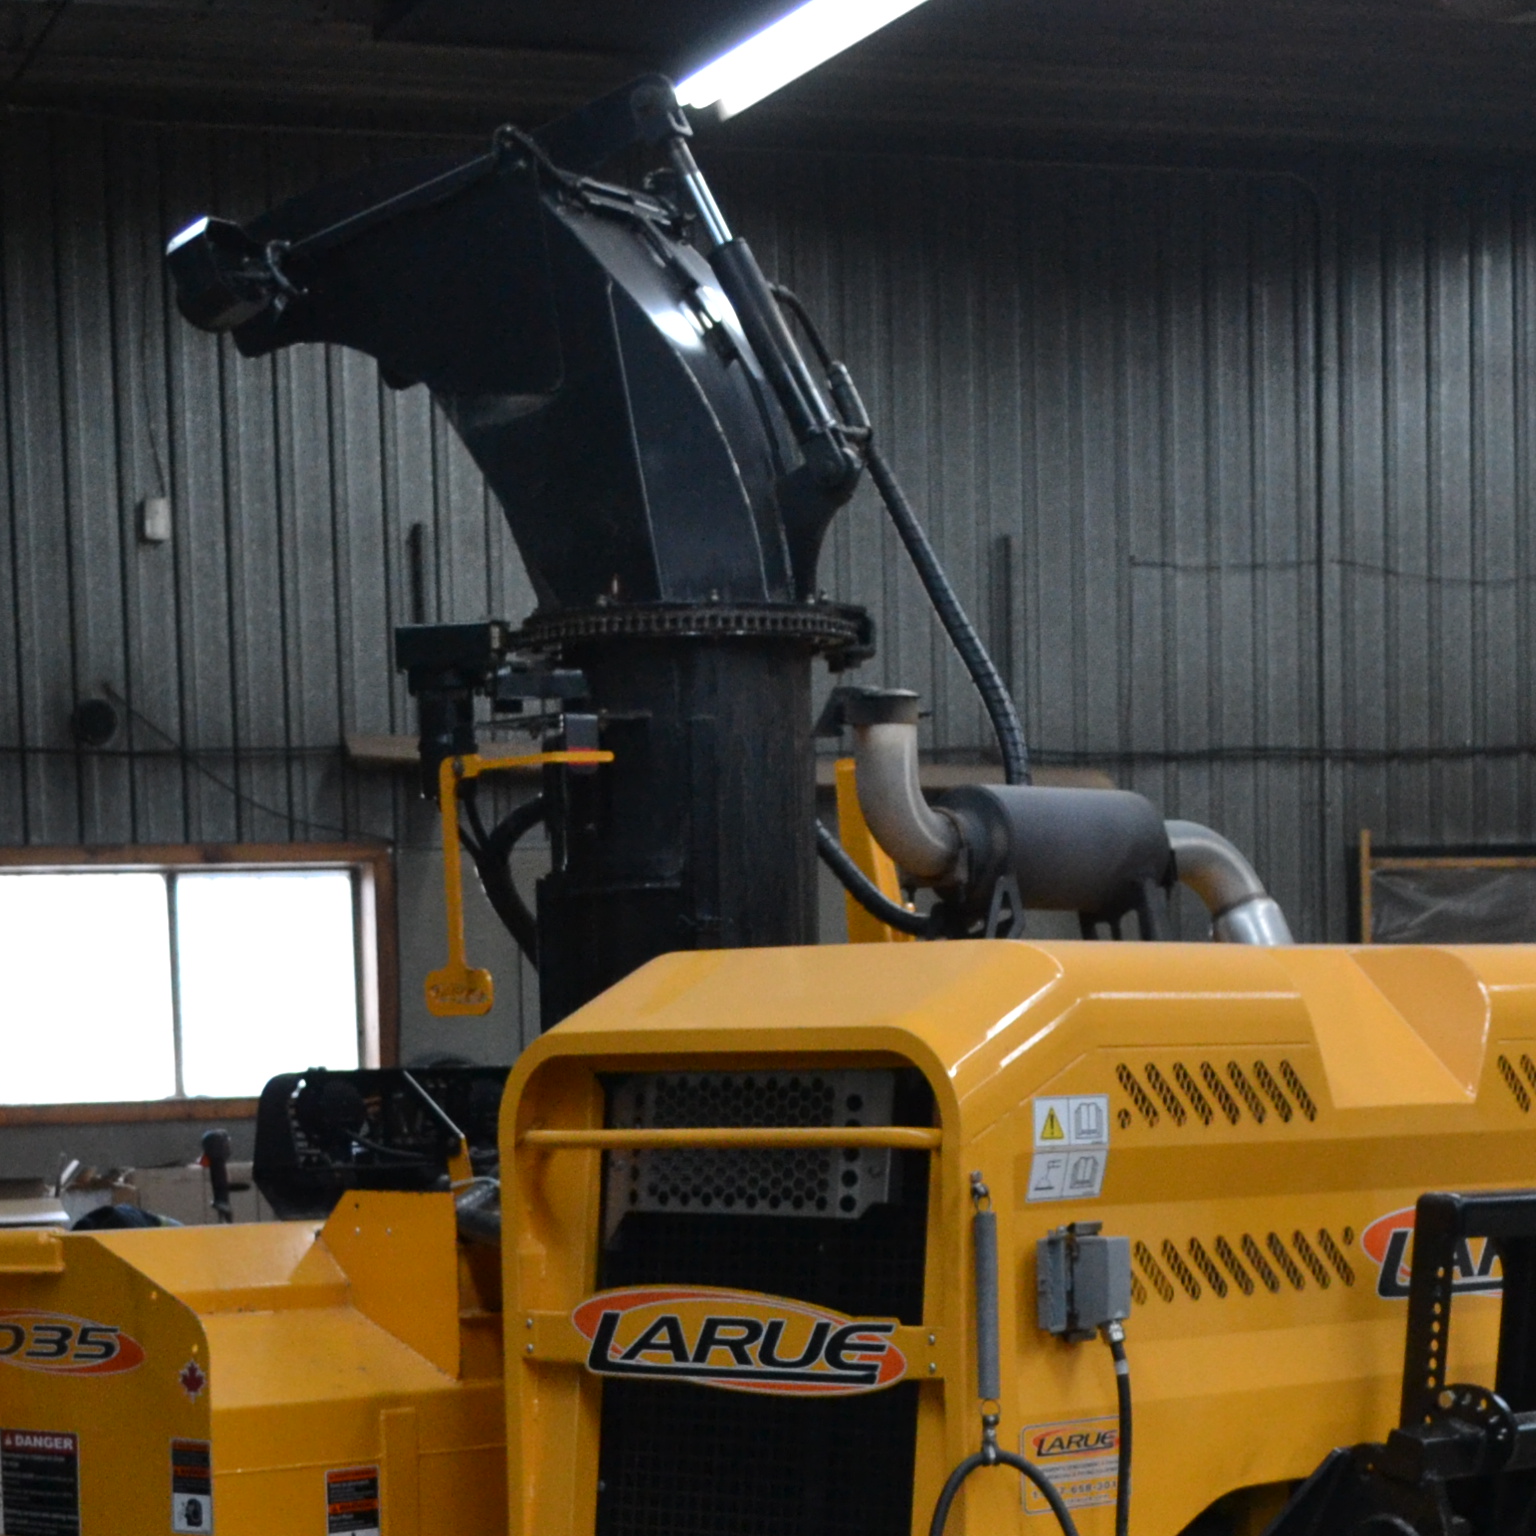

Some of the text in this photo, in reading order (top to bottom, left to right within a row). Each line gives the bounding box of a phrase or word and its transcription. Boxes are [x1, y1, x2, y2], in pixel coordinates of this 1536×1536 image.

[587, 1309, 895, 1385] LARUE
[14, 1434, 74, 1451] DANGER
[1036, 1429, 1118, 1457] LARUE
